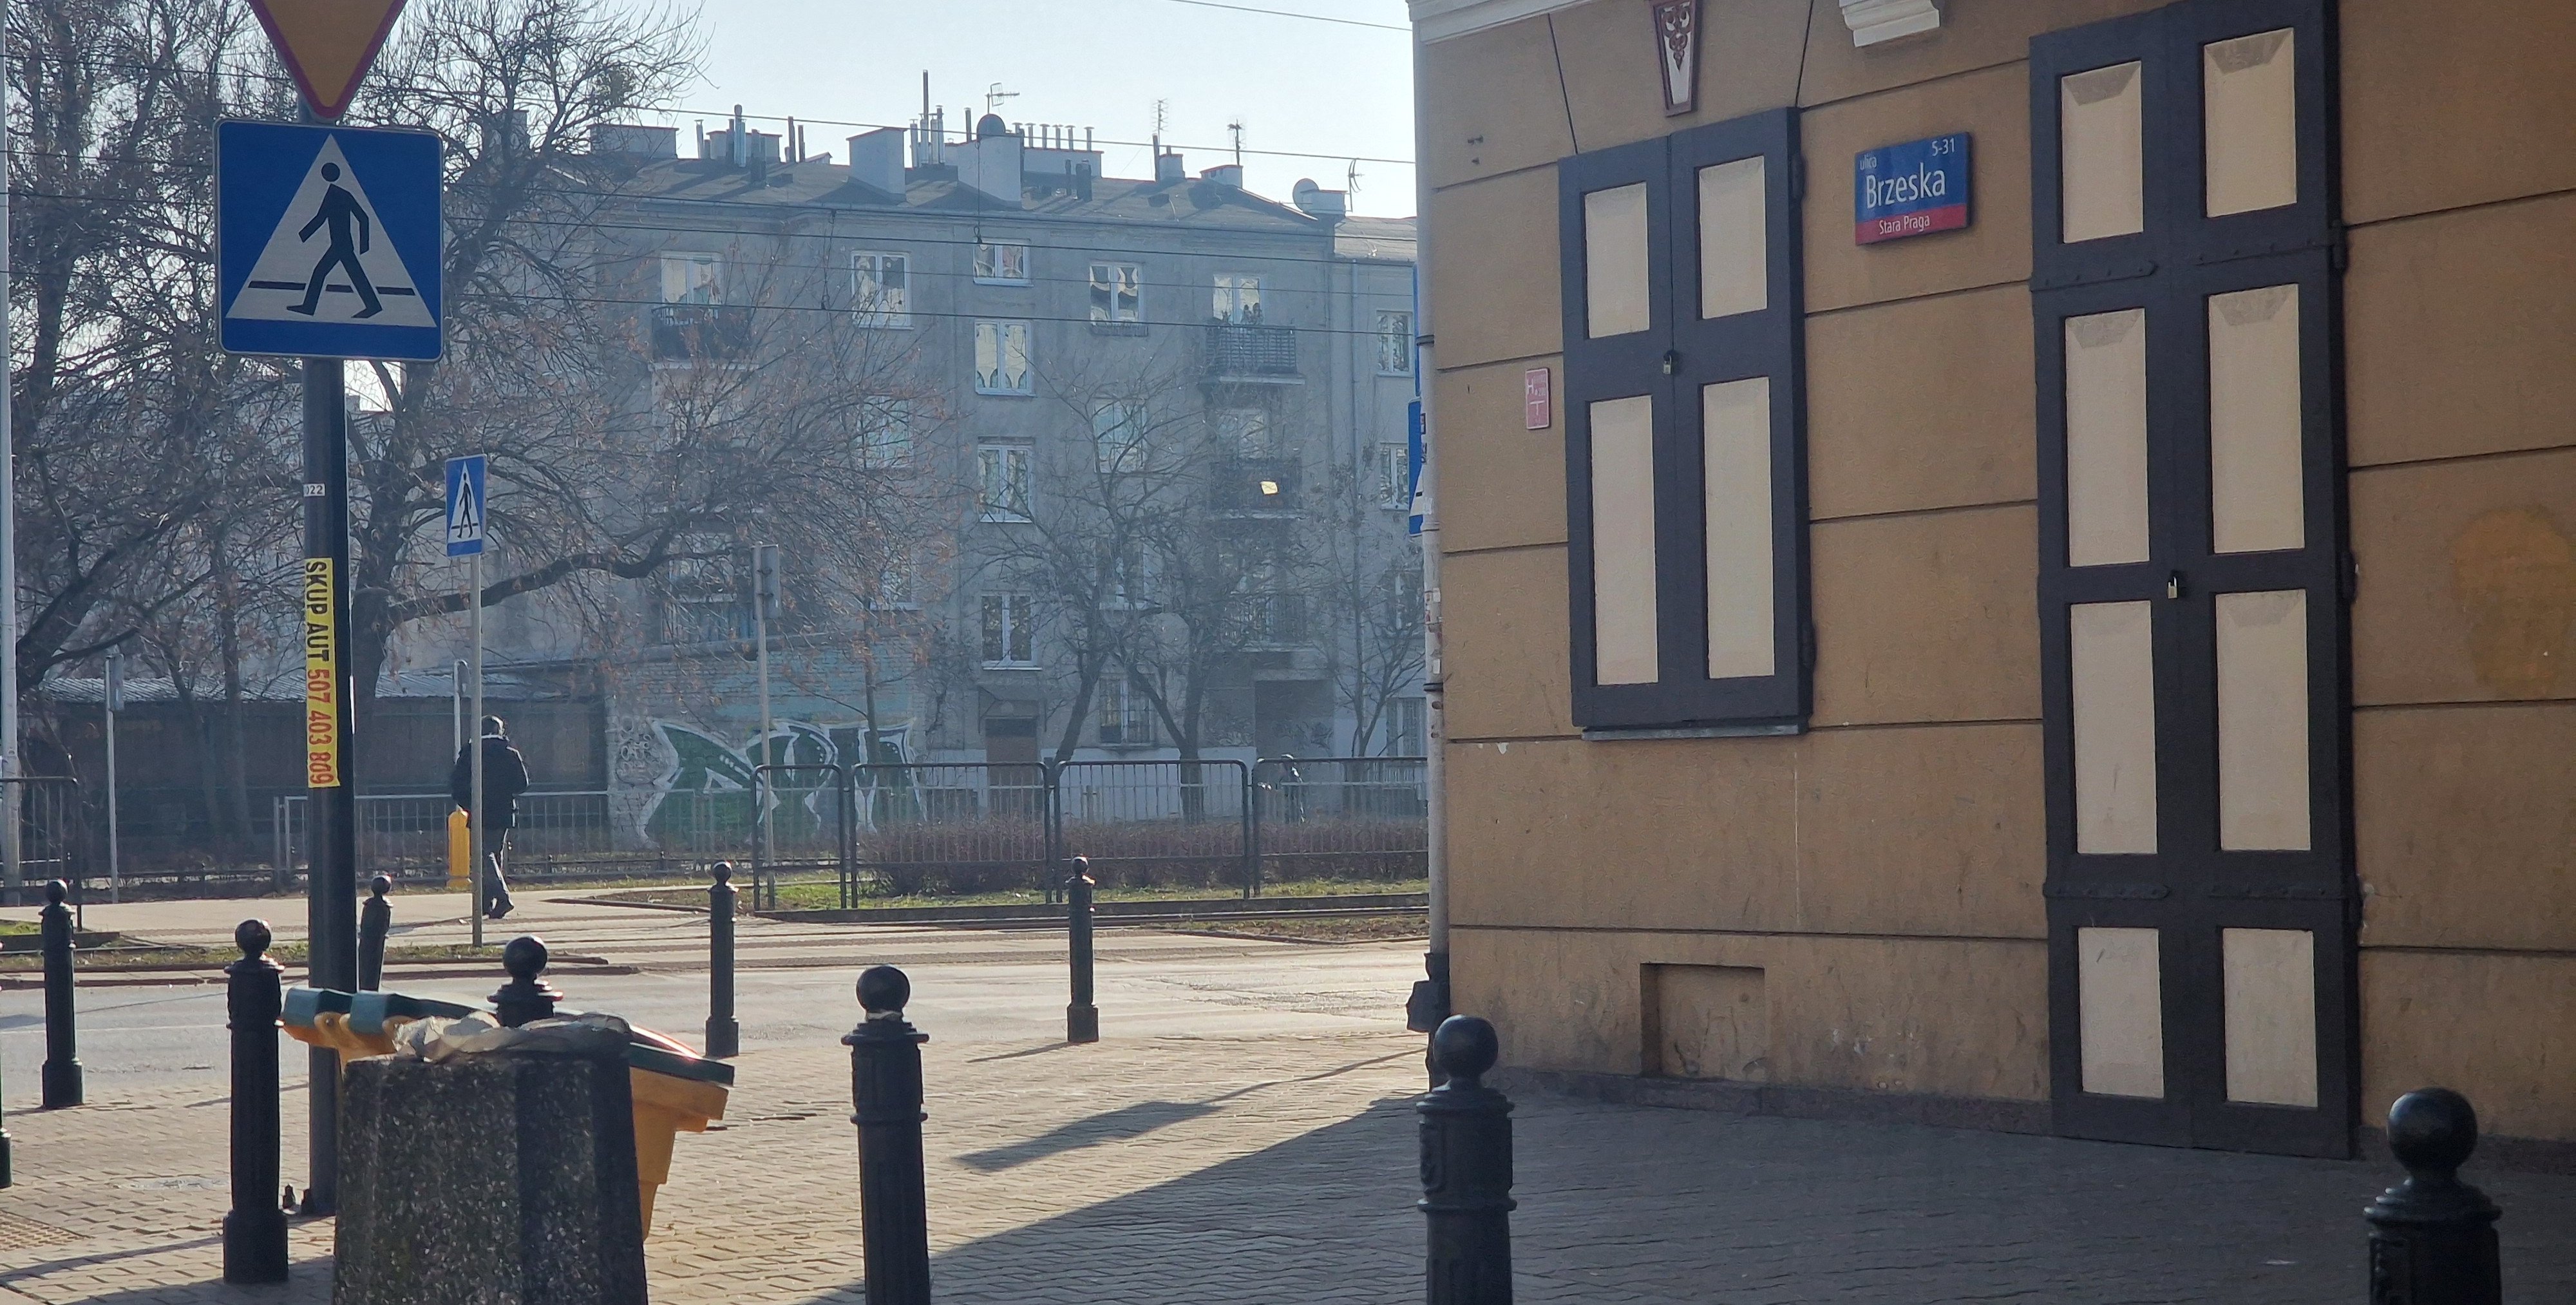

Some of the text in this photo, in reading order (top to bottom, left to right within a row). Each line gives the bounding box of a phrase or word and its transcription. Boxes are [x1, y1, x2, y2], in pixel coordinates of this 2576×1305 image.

[1932, 138, 1955, 157] 5-31
[1860, 154, 1877, 170] ulica
[1866, 162, 1946, 209] Brzeska
[1879, 215, 1930, 234] Stara Praga
[305, 561, 334, 785] SKUP AUT 507 403 809
